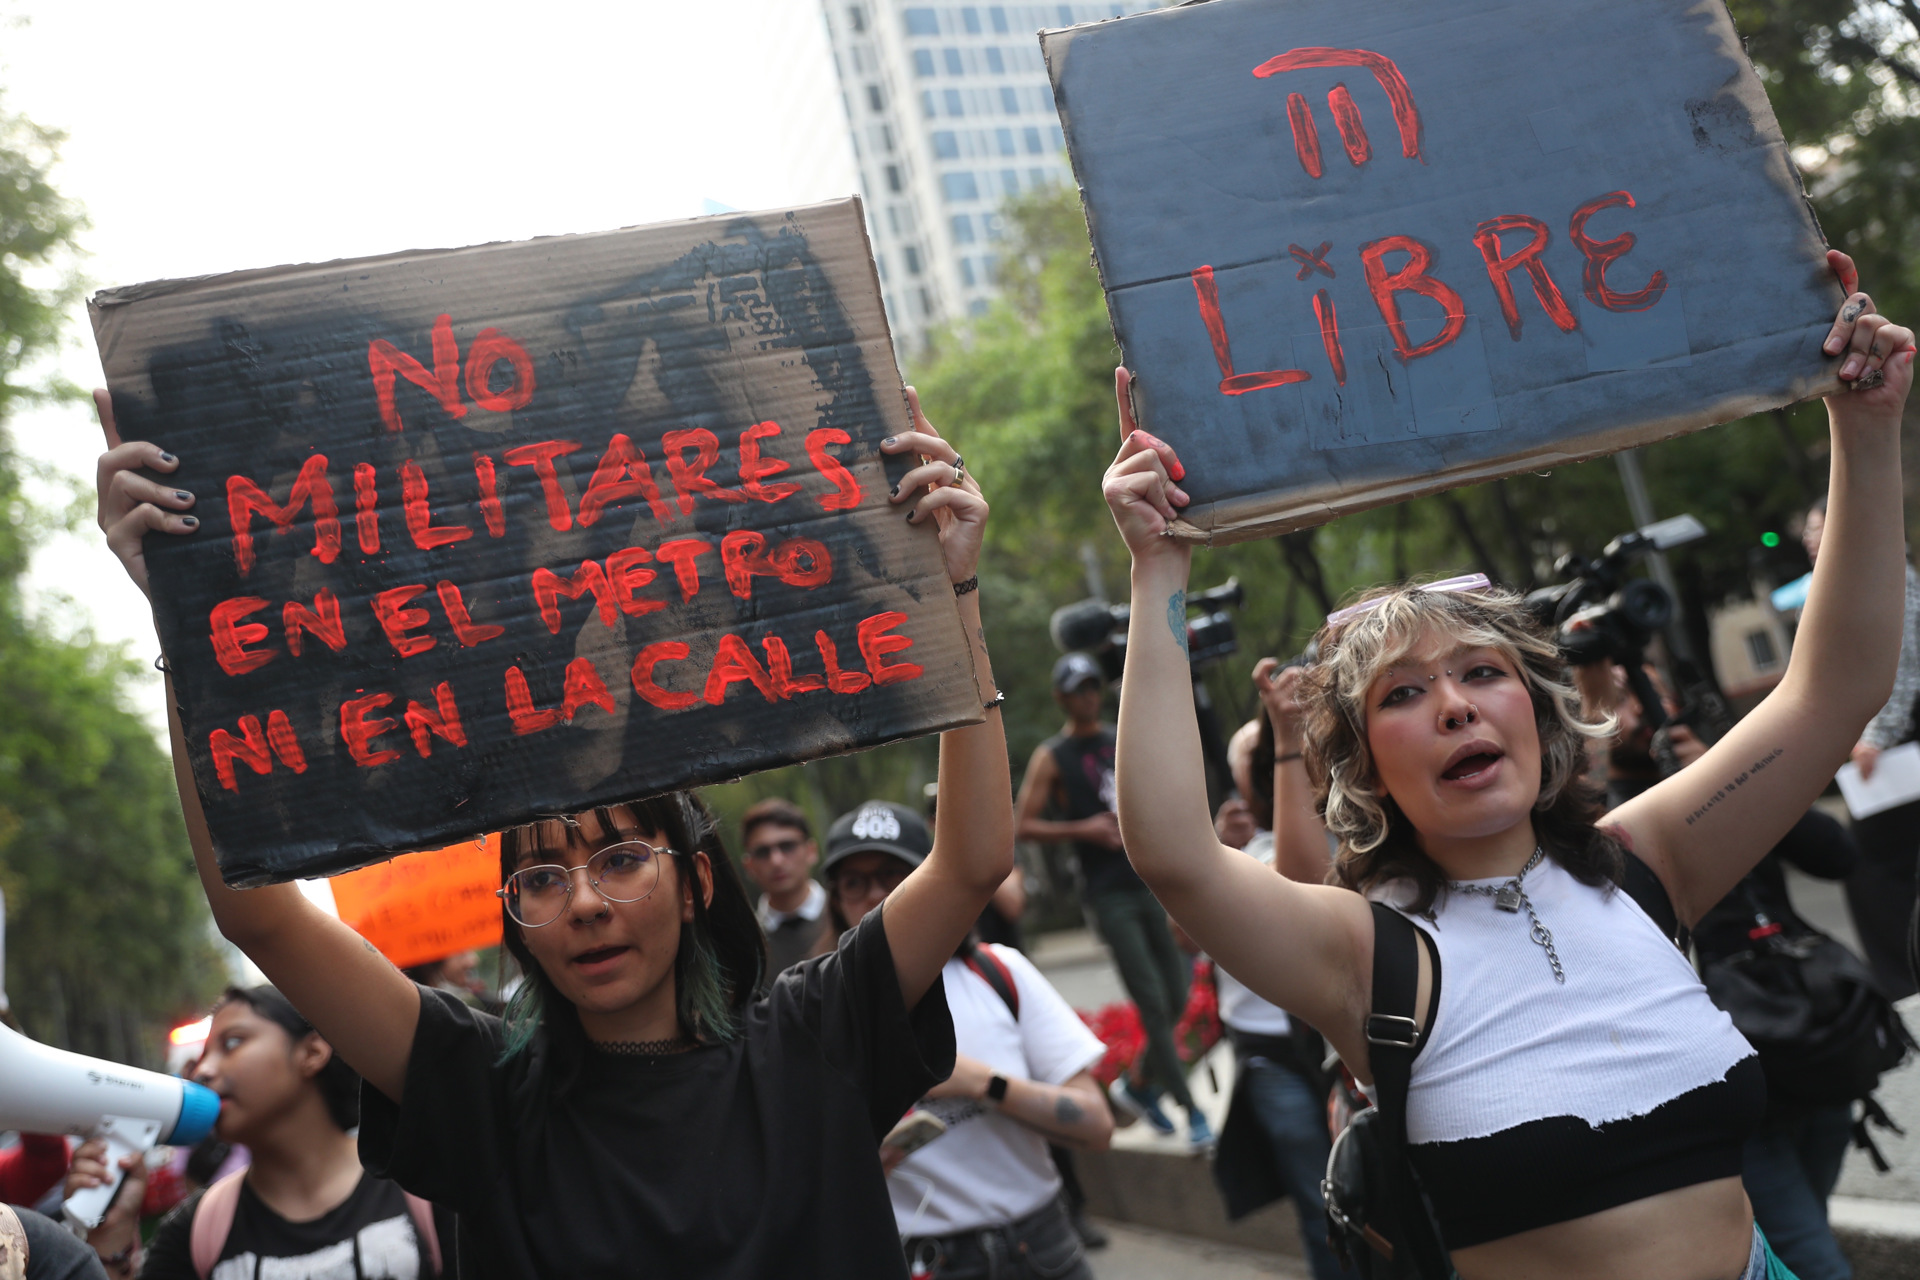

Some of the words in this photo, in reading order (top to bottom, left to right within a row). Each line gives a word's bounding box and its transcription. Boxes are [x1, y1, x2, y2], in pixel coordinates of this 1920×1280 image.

[368, 312, 537, 432] NO
[225, 420, 868, 575] MILITARES
[208, 586, 346, 677] EN
[370, 578, 506, 658] EL
[530, 528, 835, 635] METRO
[208, 708, 308, 792] NI
[338, 680, 468, 767] EN
[503, 656, 617, 735] LA
[629, 609, 925, 711] CALLE
[1723, 783, 1736, 793] TO
